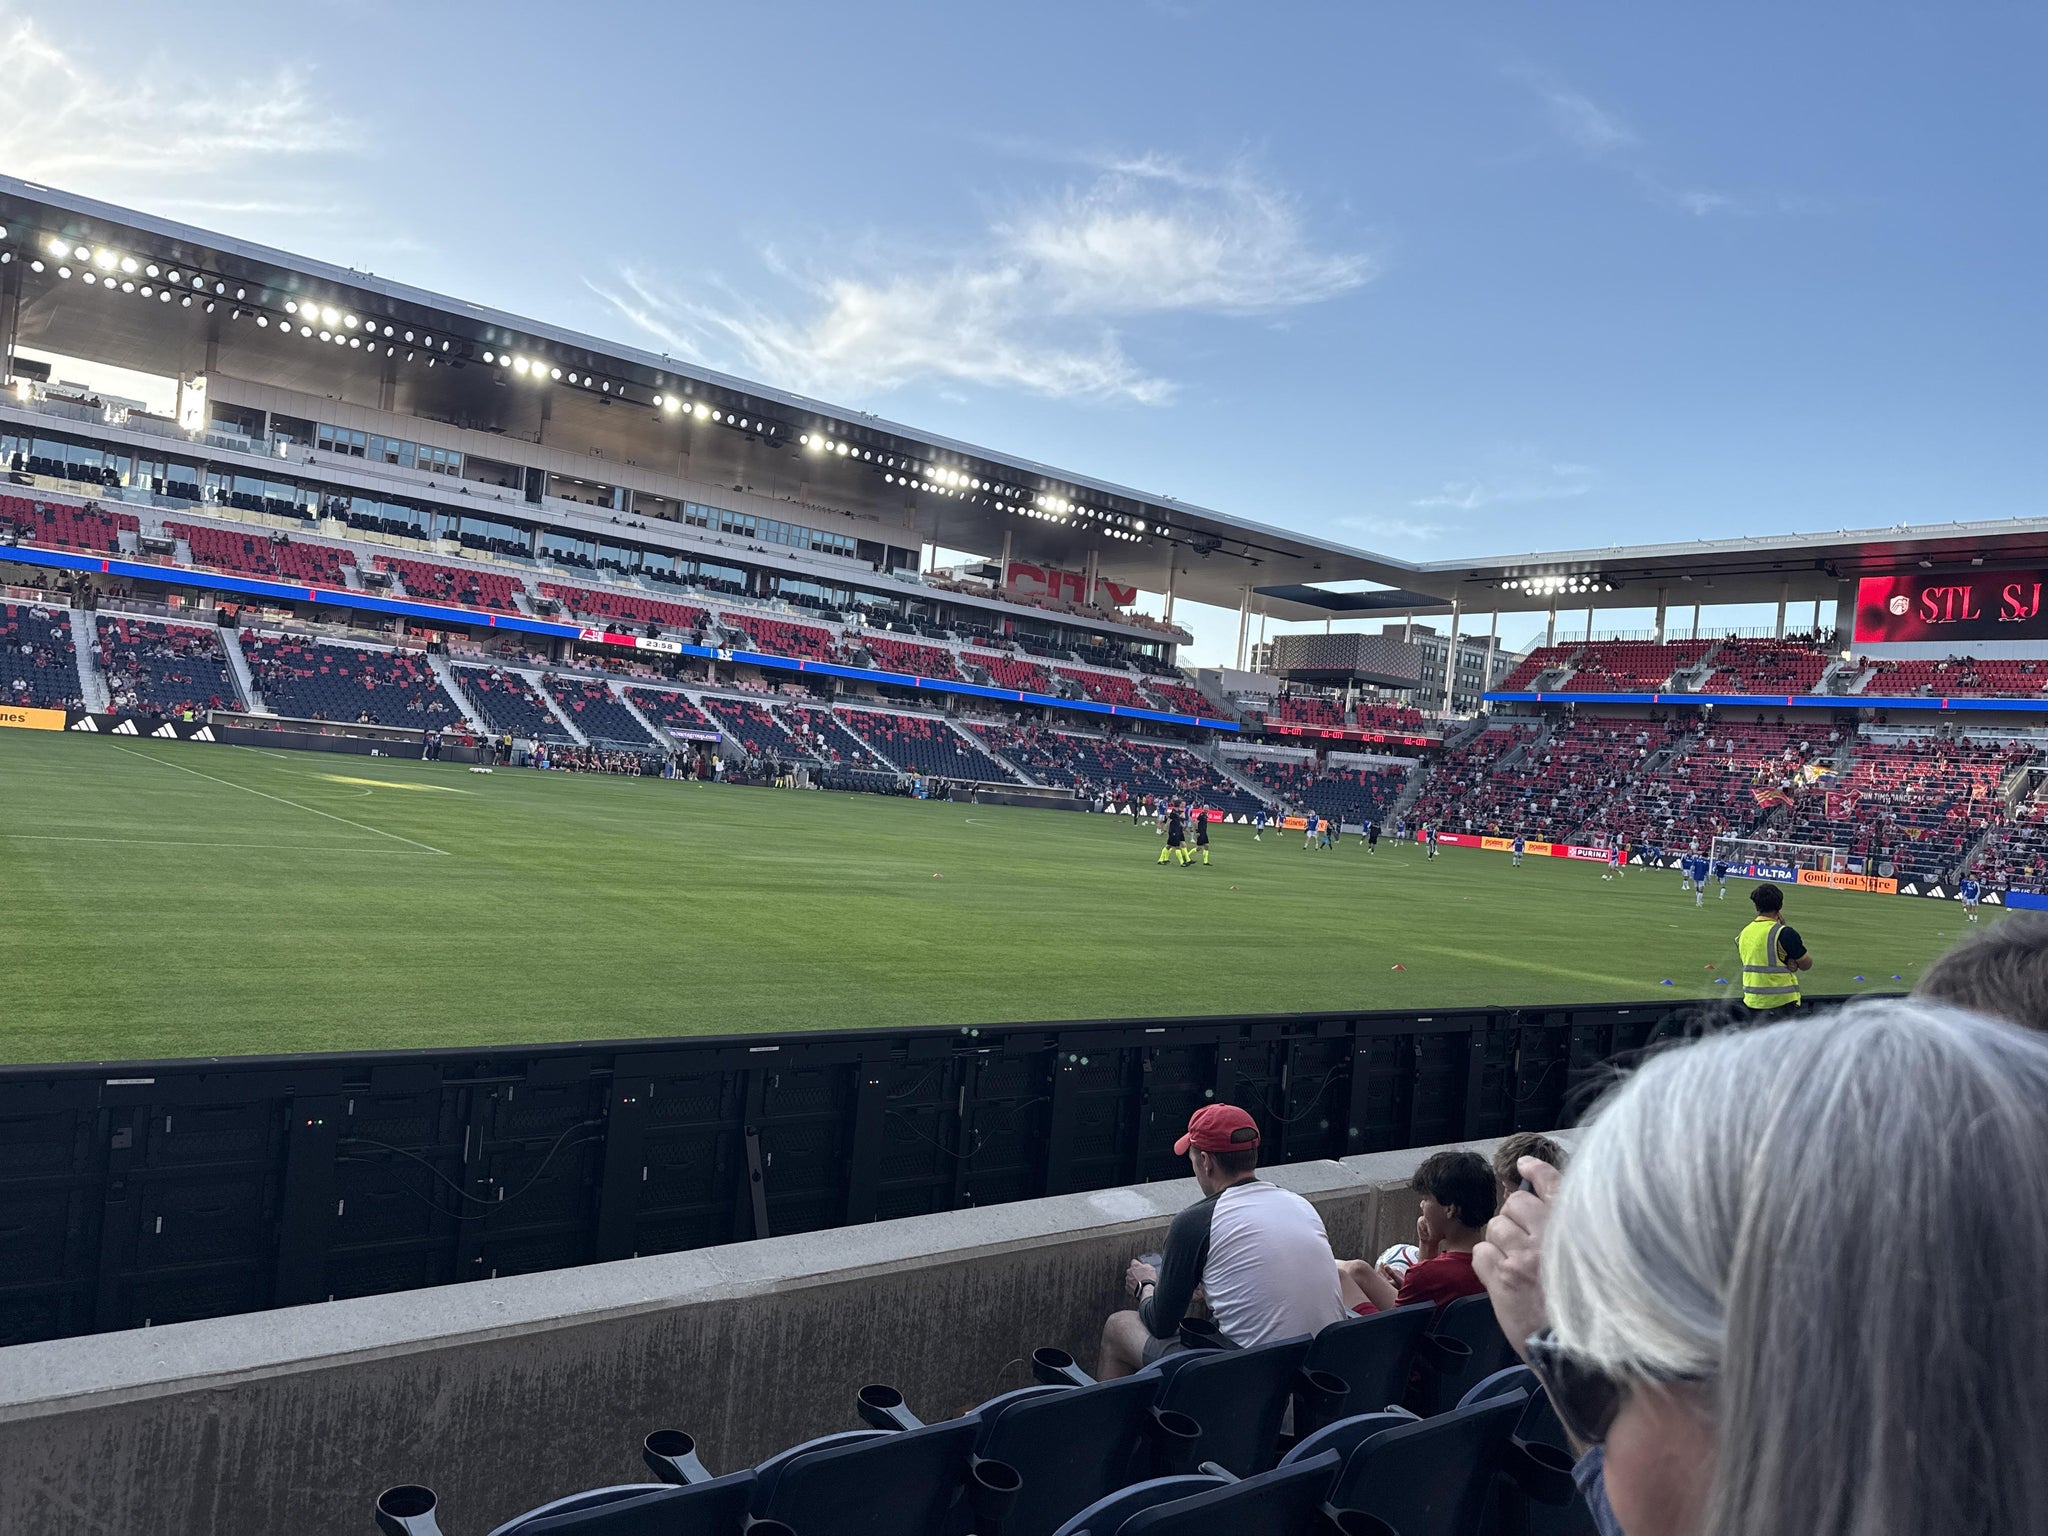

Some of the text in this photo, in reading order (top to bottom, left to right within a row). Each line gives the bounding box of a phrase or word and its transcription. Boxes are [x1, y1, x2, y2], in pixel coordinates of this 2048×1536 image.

[1007, 562, 1137, 605] CITY
[1920, 583, 2042, 620] STL SJ
[646, 640, 673, 650] 23:58
[0, 713, 25, 723] nes
[1279, 727, 1427, 747] ALL-CITY ALL-CITY ALL-CITY ALL-CITY
[1577, 849, 1608, 859] PURINA
[1757, 868, 1792, 878] ULTRA
